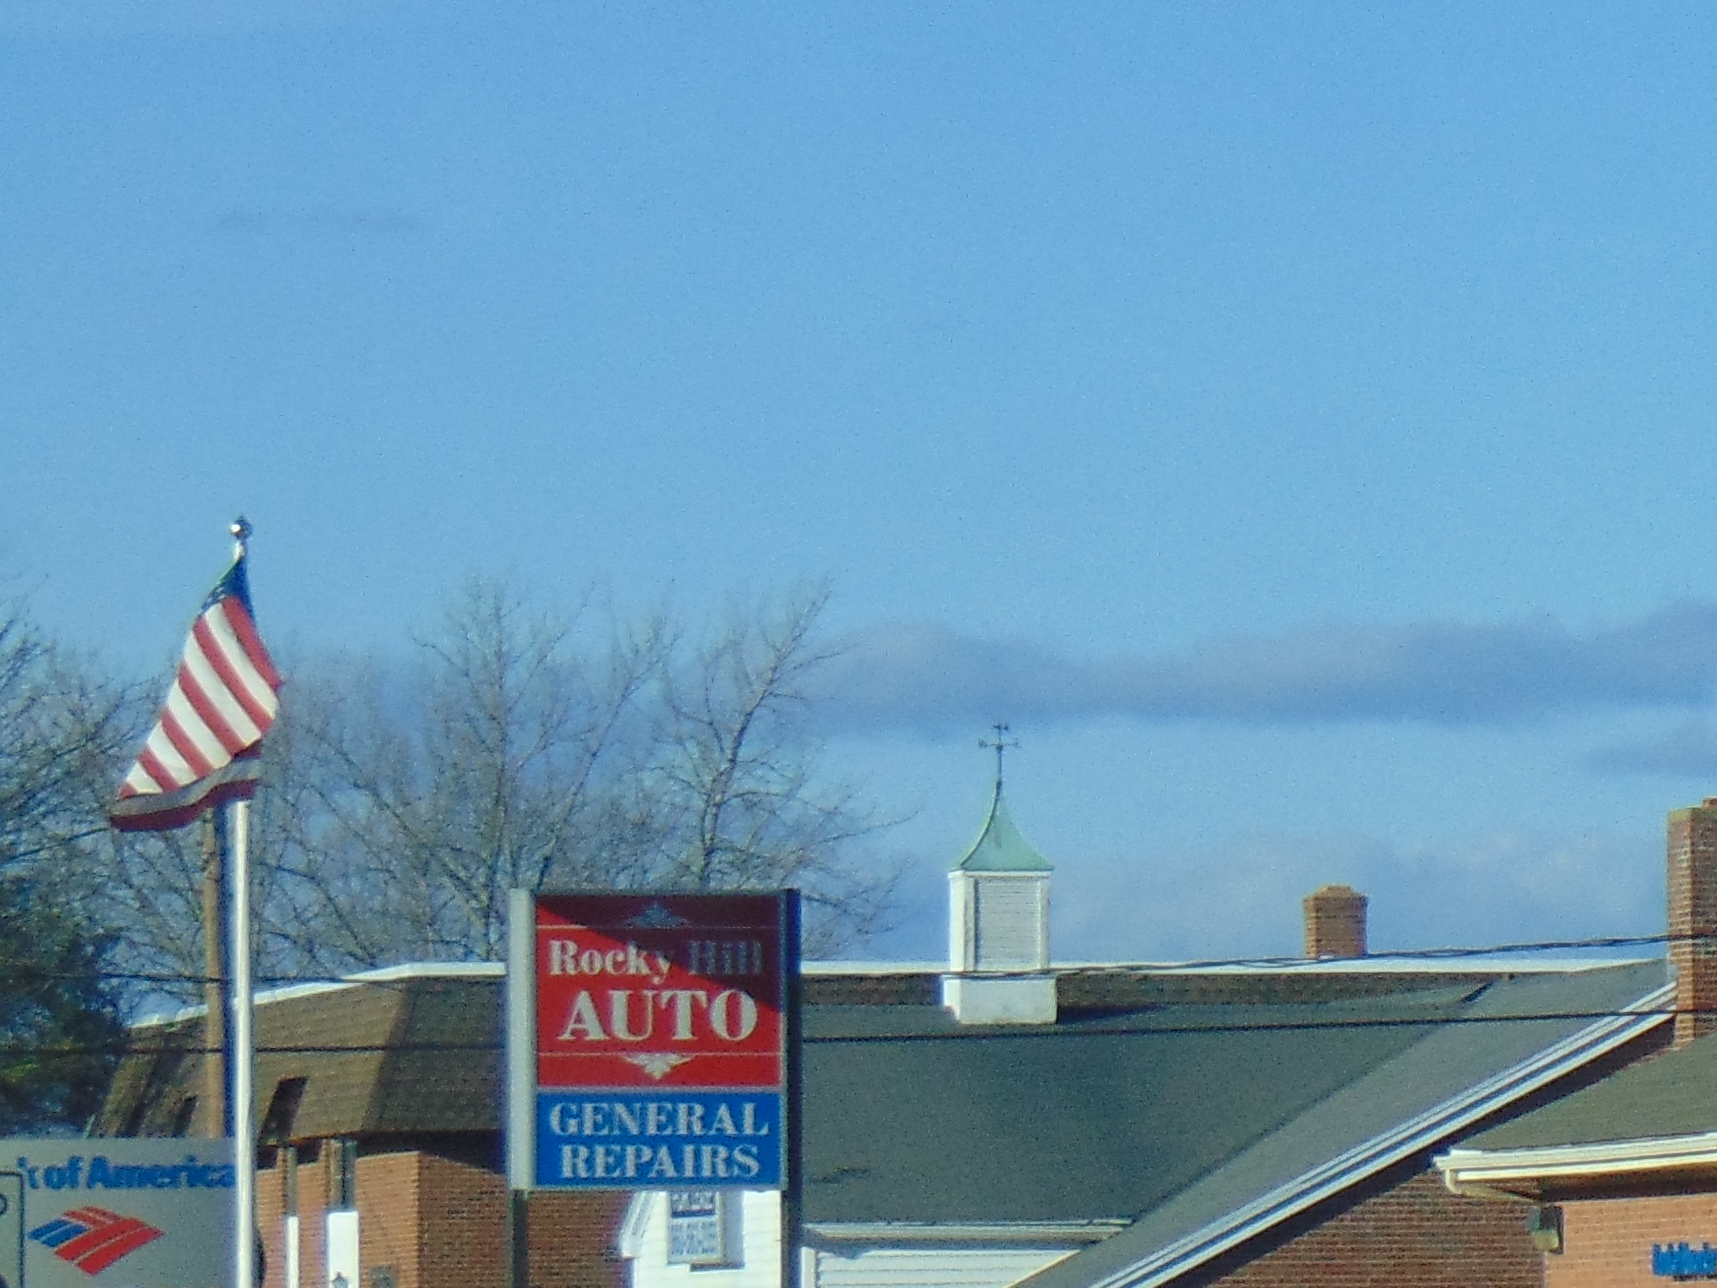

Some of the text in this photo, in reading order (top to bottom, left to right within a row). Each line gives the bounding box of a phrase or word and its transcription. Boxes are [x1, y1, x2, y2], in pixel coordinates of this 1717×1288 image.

[549, 939, 763, 984] Rocky Hill
[556, 988, 758, 1042] AUTO
[549, 1101, 769, 1136] GENERAL
[44, 1155, 83, 1190] of
[560, 1144, 761, 1179] REPAIRS
